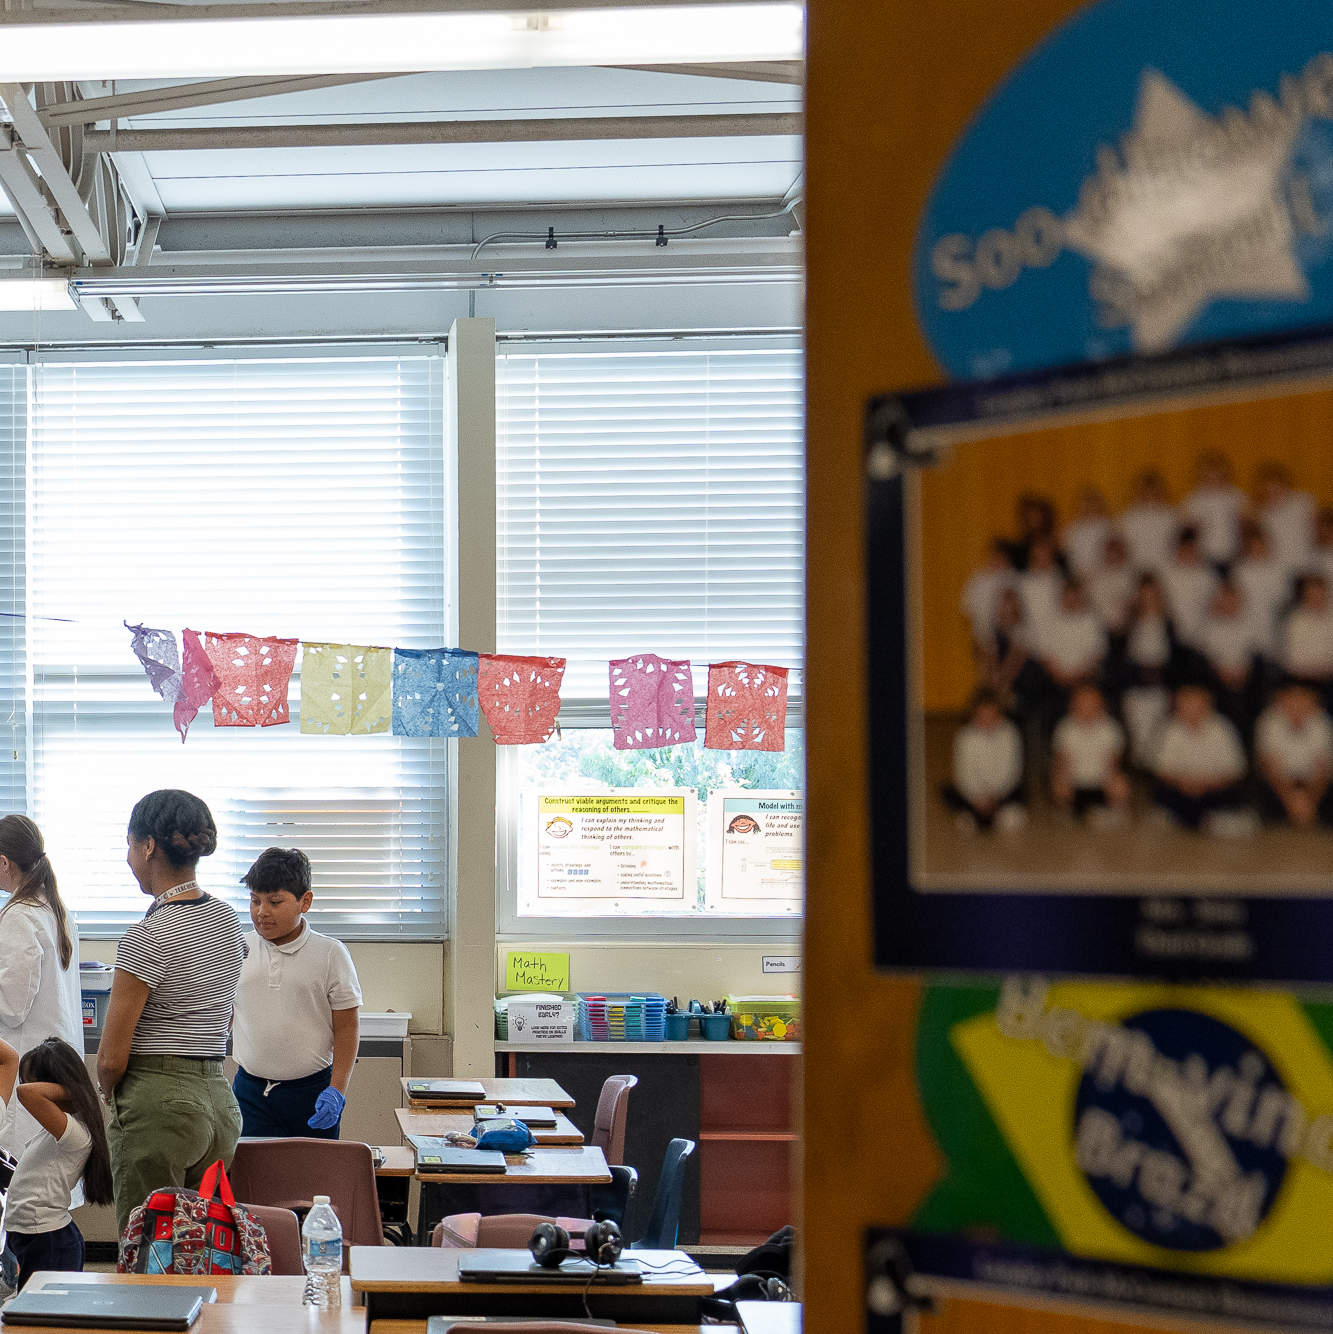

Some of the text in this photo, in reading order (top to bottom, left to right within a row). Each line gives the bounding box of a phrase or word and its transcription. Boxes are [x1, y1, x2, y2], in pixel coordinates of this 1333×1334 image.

[595, 798, 628, 806] arguments
[642, 798, 666, 806] critique
[758, 802, 779, 810] Model
[596, 817, 617, 825] explain
[628, 817, 652, 825] thinking
[581, 825, 604, 833] respond
[513, 957, 547, 972] Math
[515, 971, 564, 990] Mastery
